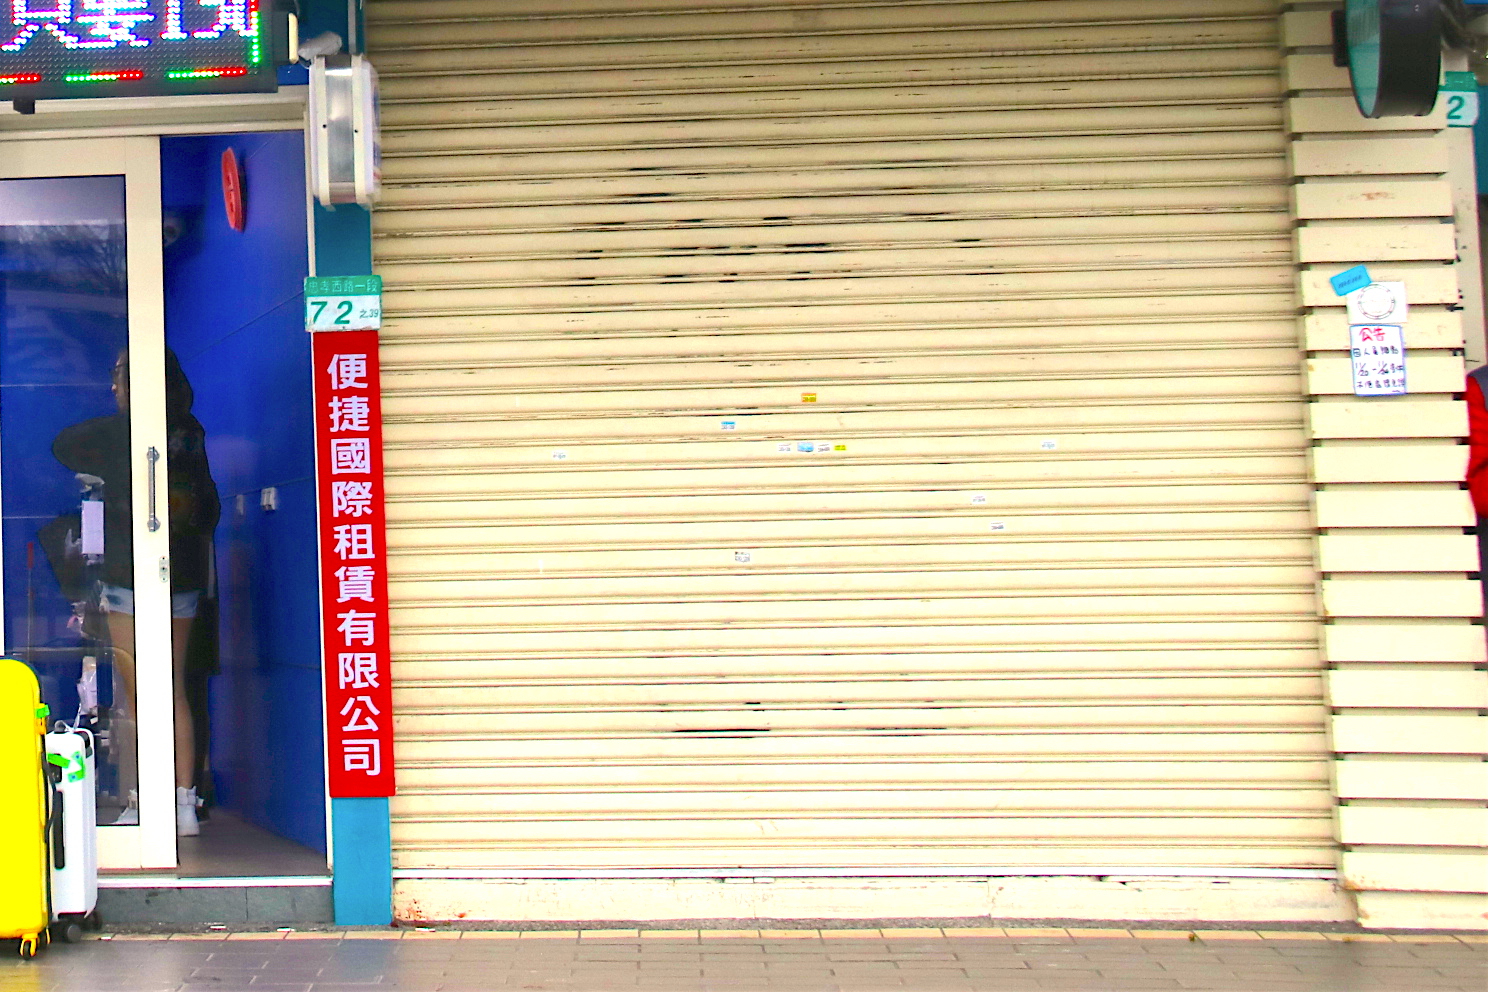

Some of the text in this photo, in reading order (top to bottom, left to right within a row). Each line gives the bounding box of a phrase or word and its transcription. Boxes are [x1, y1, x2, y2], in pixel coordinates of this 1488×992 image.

[310, 300, 353, 325] 72
[326, 352, 382, 778] 便捷國際租賃有限公司
